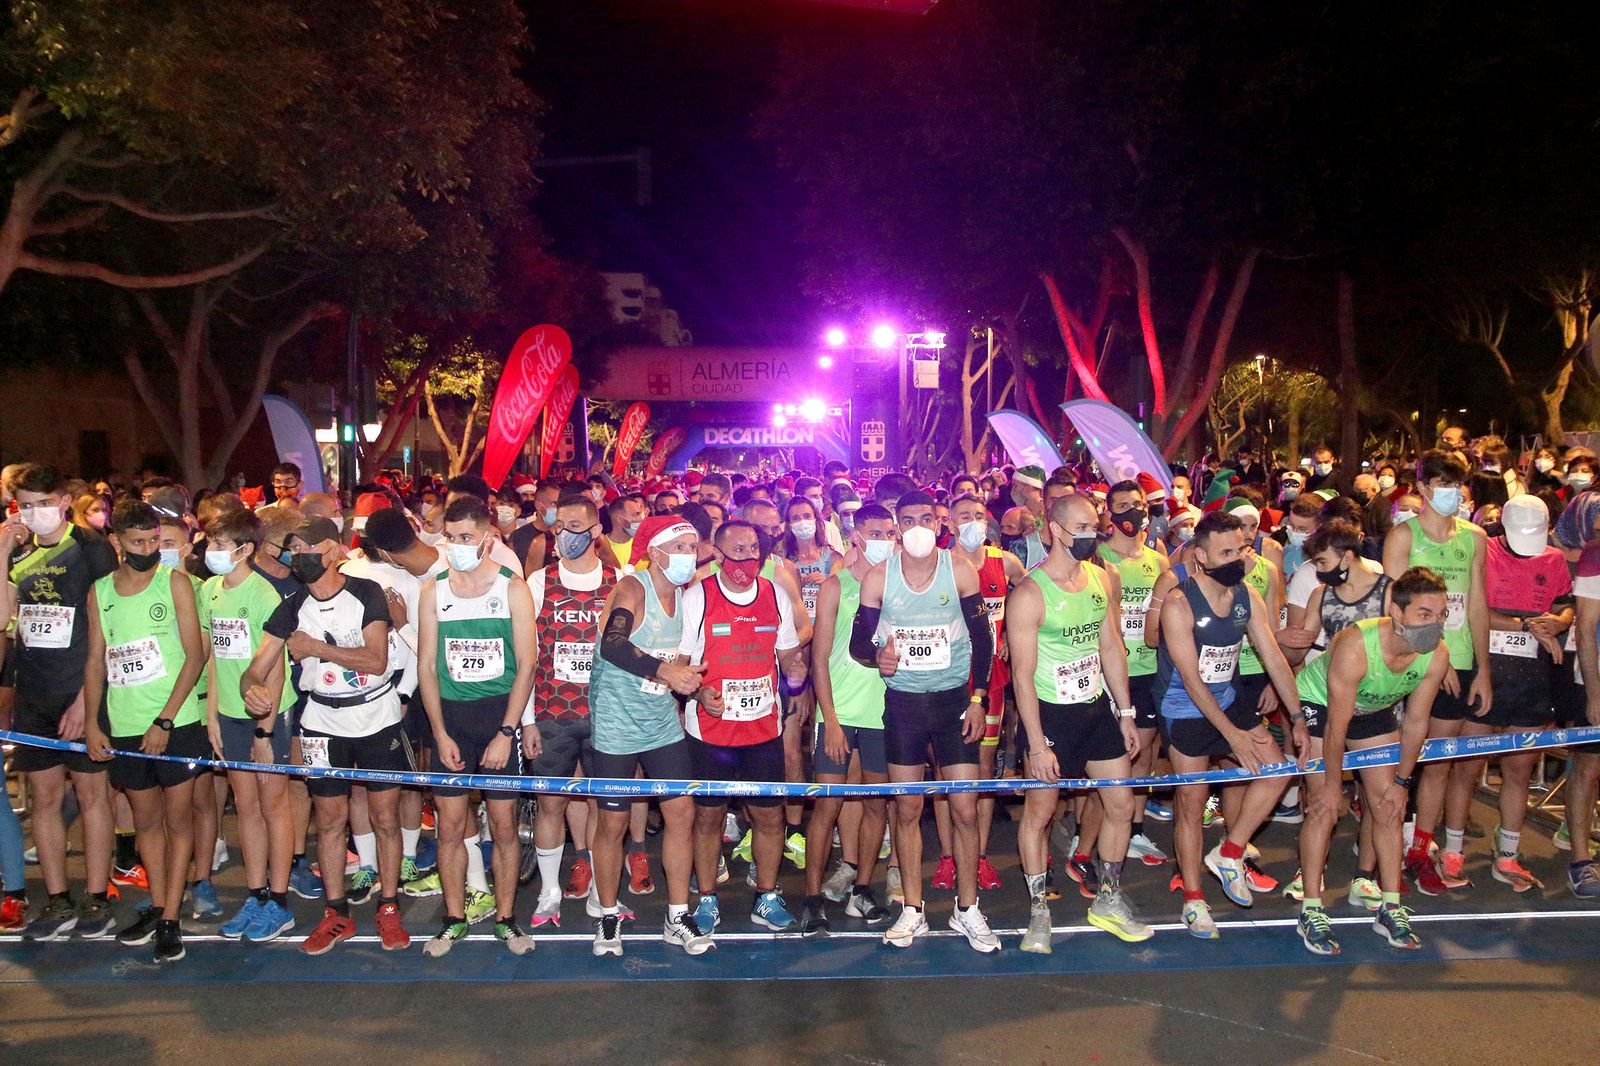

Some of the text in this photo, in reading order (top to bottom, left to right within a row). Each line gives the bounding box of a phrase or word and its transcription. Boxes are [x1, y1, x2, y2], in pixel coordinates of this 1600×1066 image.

[691, 359, 791, 380] ALMERÍA
[691, 383, 743, 394] CIUDAD
[704, 427, 815, 445] DECATHLON
[30, 622, 52, 634] 812
[1126, 620, 1143, 629] 858
[213, 636, 231, 647] 280
[1505, 635, 1526, 646] 228
[909, 646, 932, 657] 800
[122, 660, 144, 674] 875
[462, 658, 485, 669] 279
[570, 661, 592, 671] 366
[1214, 661, 1232, 672] 929
[1078, 676, 1090, 689] 85
[740, 696, 761, 708] 517
